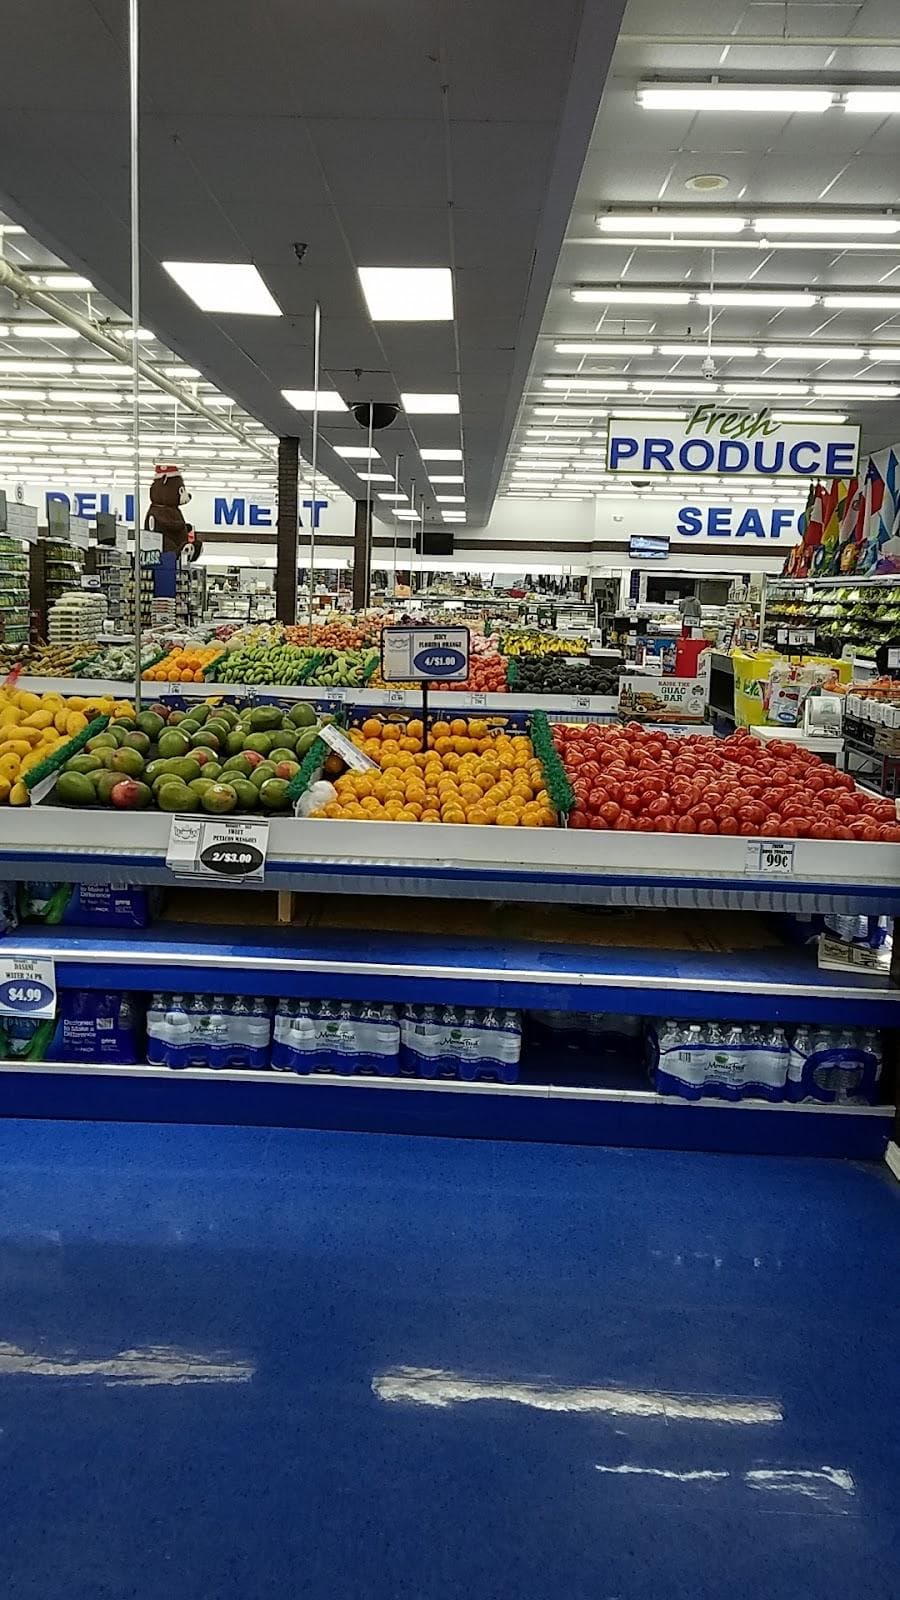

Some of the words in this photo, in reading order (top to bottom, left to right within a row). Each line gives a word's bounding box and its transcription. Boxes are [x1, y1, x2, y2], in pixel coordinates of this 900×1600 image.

[685, 404, 782, 439] Fresh
[609, 437, 857, 475] PRODUCE
[214, 498, 328, 527] MET
[424, 656, 456, 666] 4/$1.00
[661, 687, 687, 695] GUAC
[663, 694, 683, 702] BAR
[212, 852, 253, 864] 2/$3.00
[8, 987, 42, 1002] $4.99
